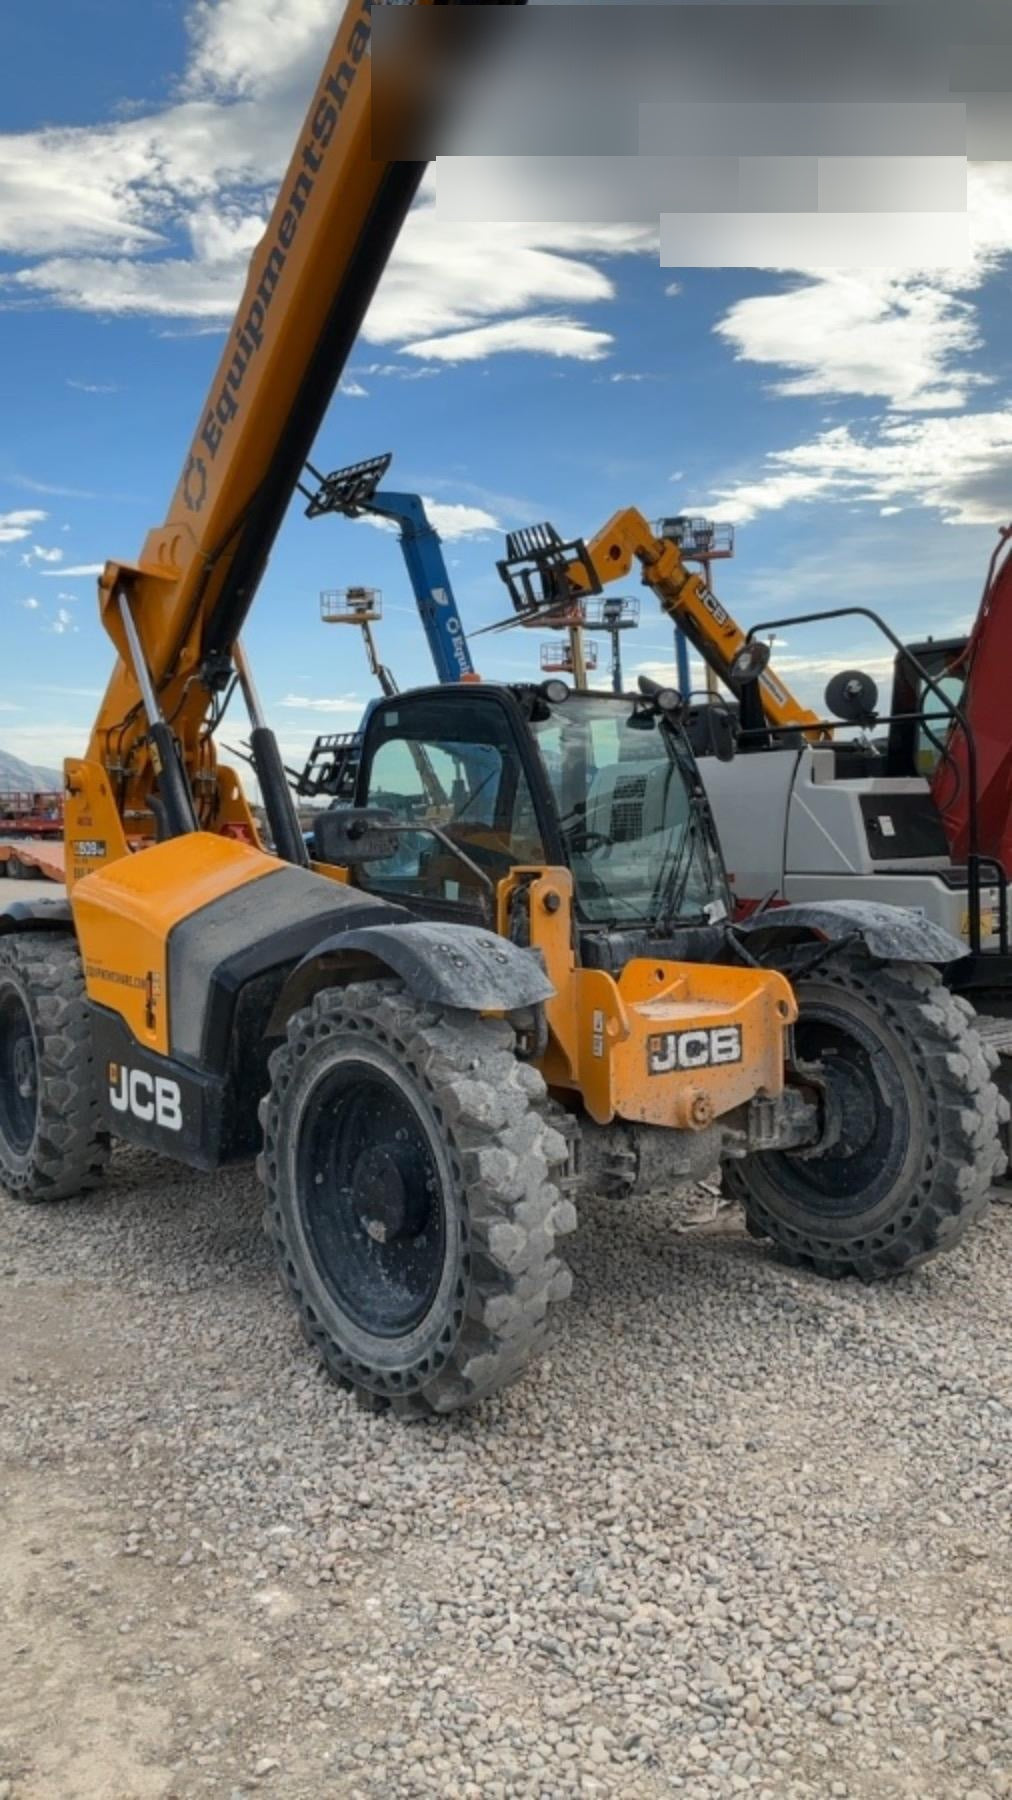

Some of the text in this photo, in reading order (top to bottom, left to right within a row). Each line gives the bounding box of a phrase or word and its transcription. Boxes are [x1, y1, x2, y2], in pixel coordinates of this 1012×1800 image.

[695, 584, 729, 625] JCB
[651, 1027, 741, 1071] JCB
[109, 1065, 183, 1131] JCB
